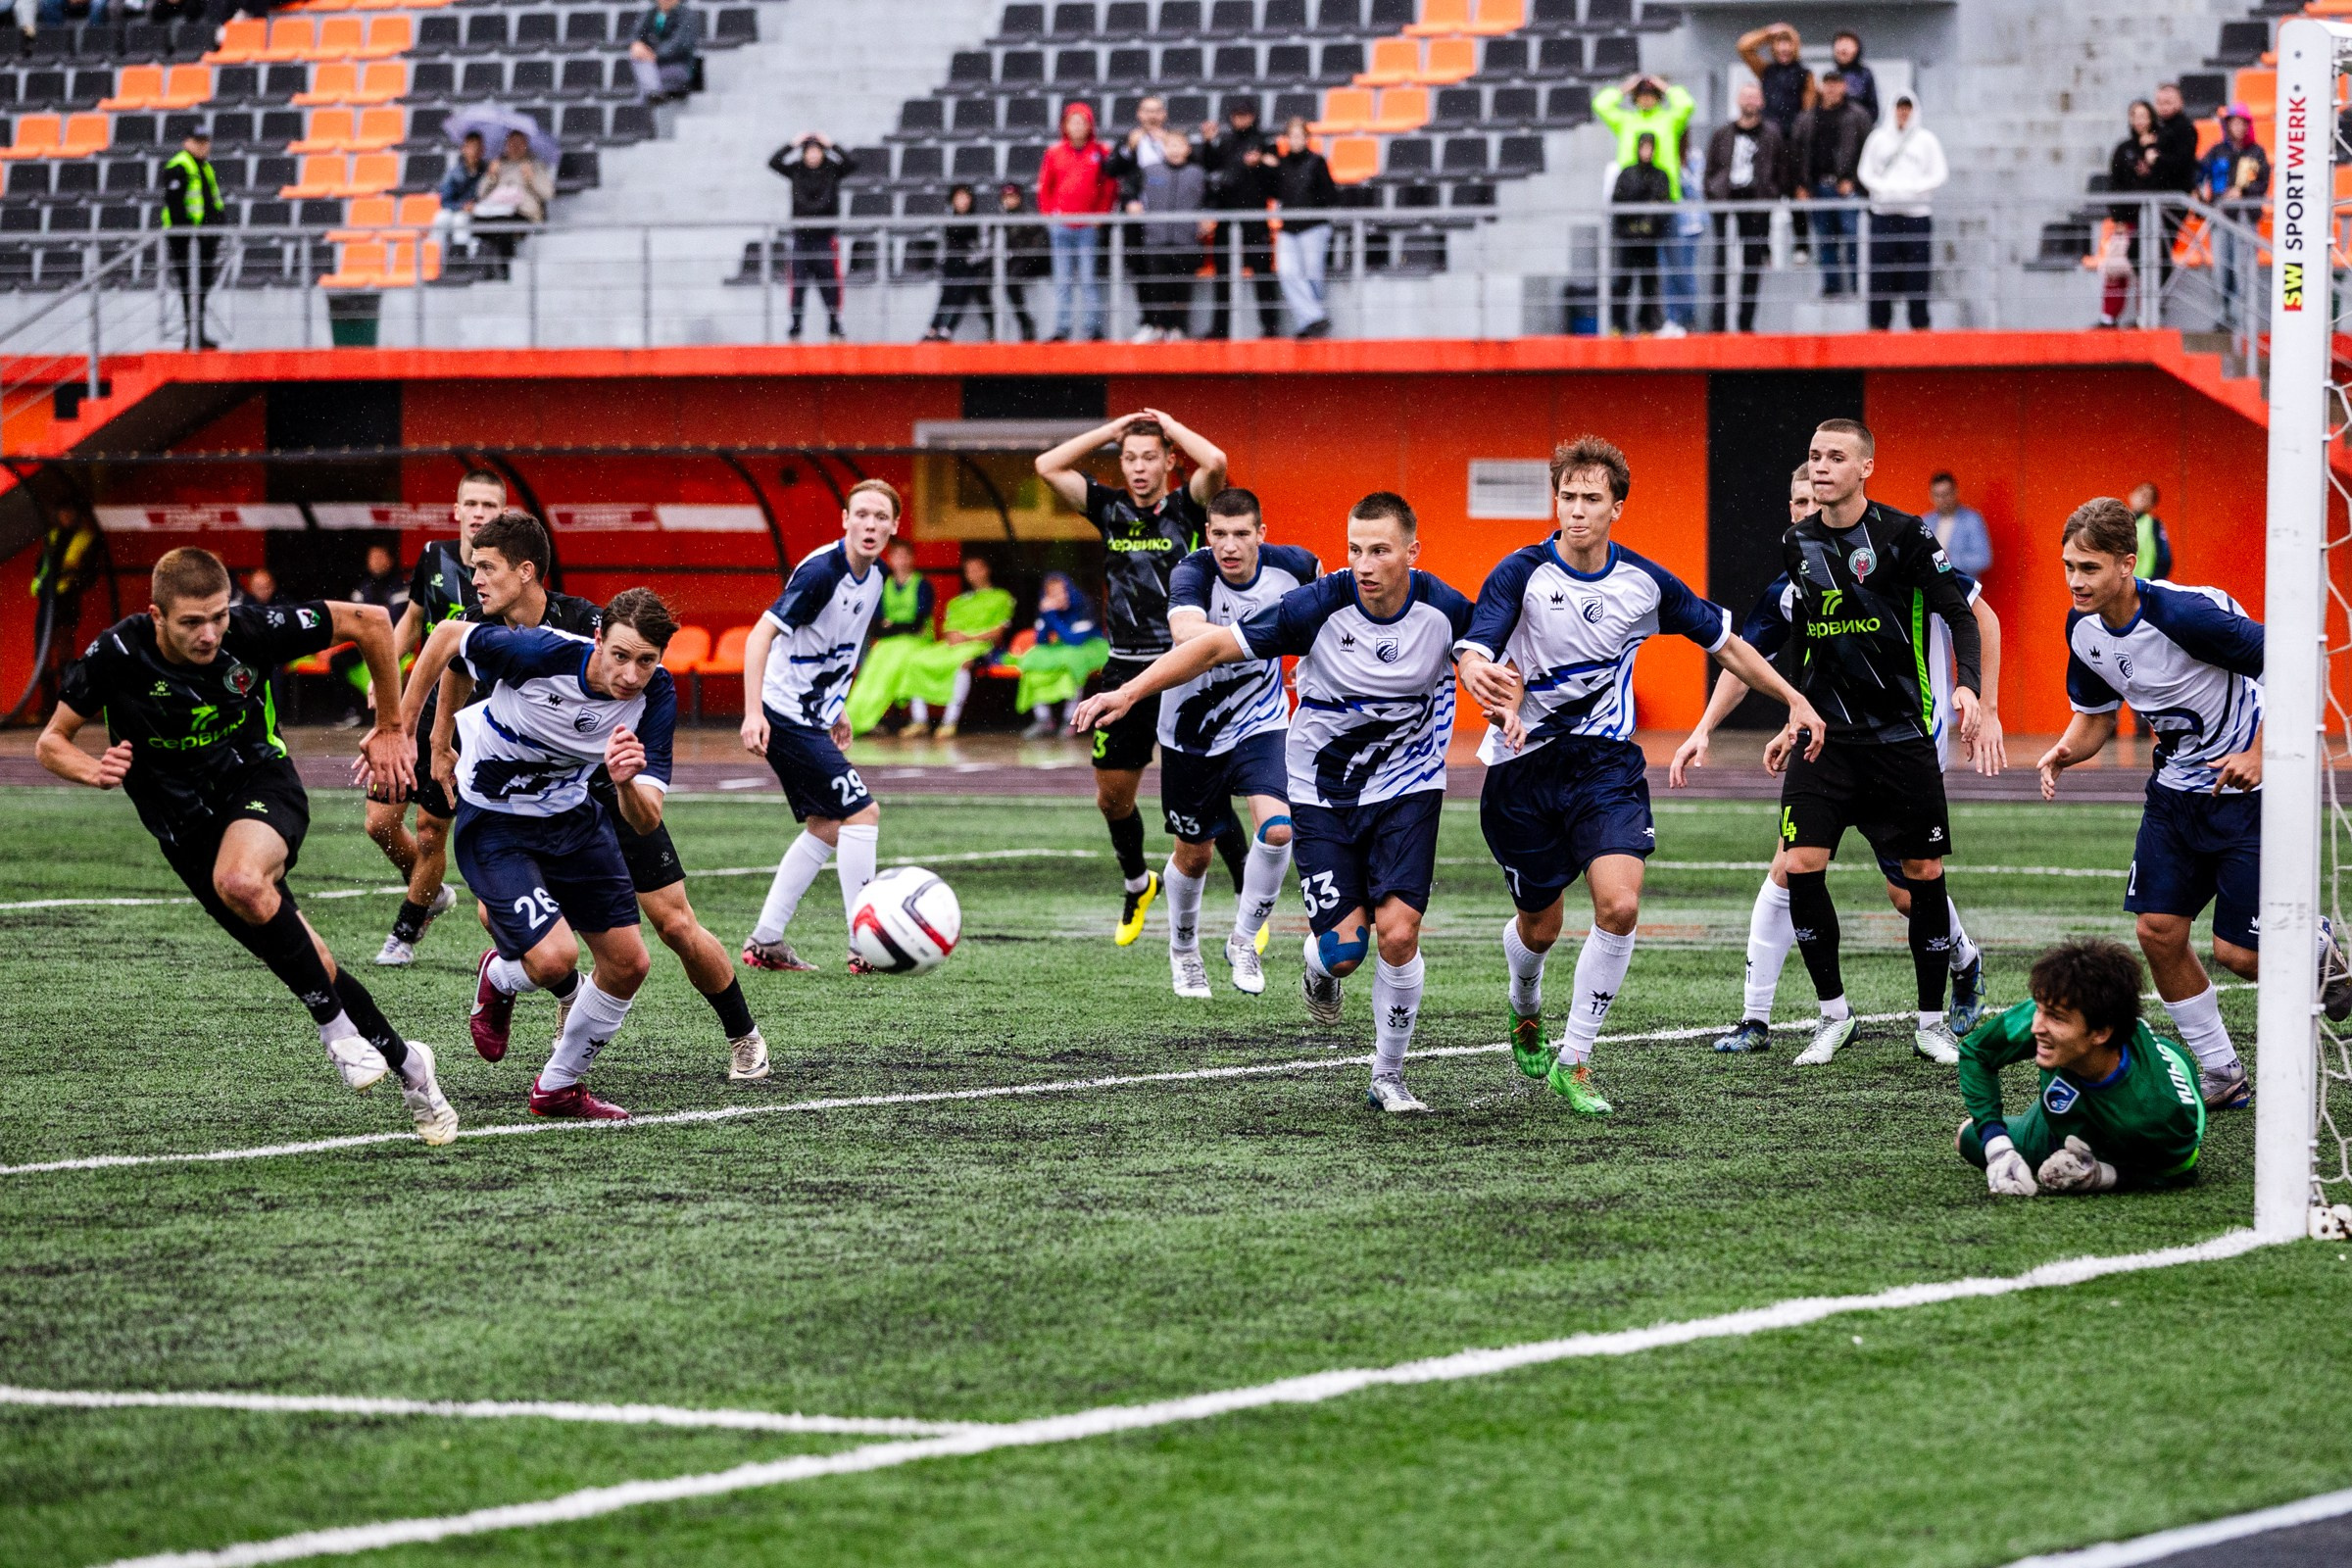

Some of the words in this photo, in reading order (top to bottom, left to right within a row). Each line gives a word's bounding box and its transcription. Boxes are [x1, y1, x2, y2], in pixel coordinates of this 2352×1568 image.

[2285, 96, 2306, 251] SPORTWERK
[2283, 263, 2303, 307] SW
[1806, 617, 1881, 639] ервико
[830, 768, 868, 807] 29
[1168, 809, 1201, 836] 83
[513, 887, 561, 930] 26
[1300, 869, 1342, 919] 33
[1387, 1014, 1411, 1029] 33
[1592, 1001, 1609, 1015] 17
